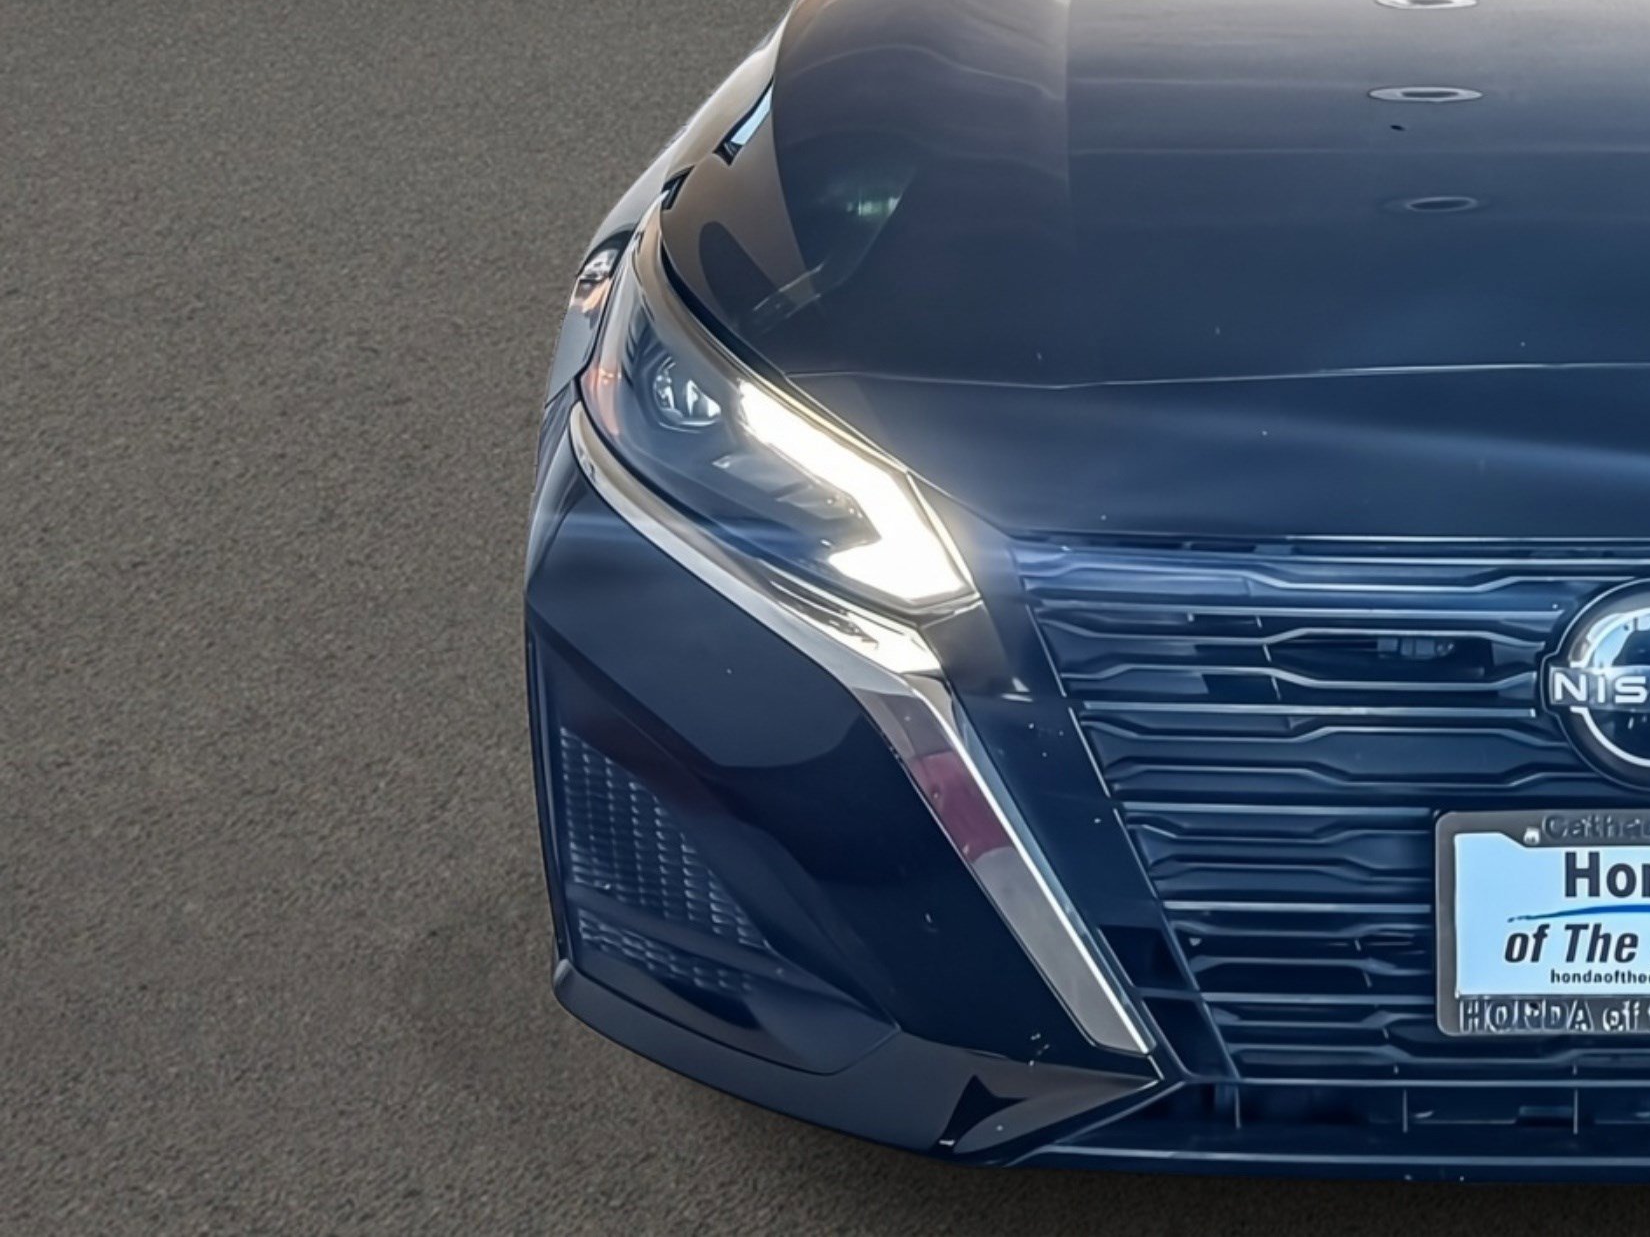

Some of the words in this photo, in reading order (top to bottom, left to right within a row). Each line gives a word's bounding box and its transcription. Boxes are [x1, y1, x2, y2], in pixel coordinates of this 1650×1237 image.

[1504, 923, 1551, 964] of
[1564, 923, 1640, 964] The
[1459, 998, 1594, 1032] HONDA
[1601, 1000, 1642, 1031] of
